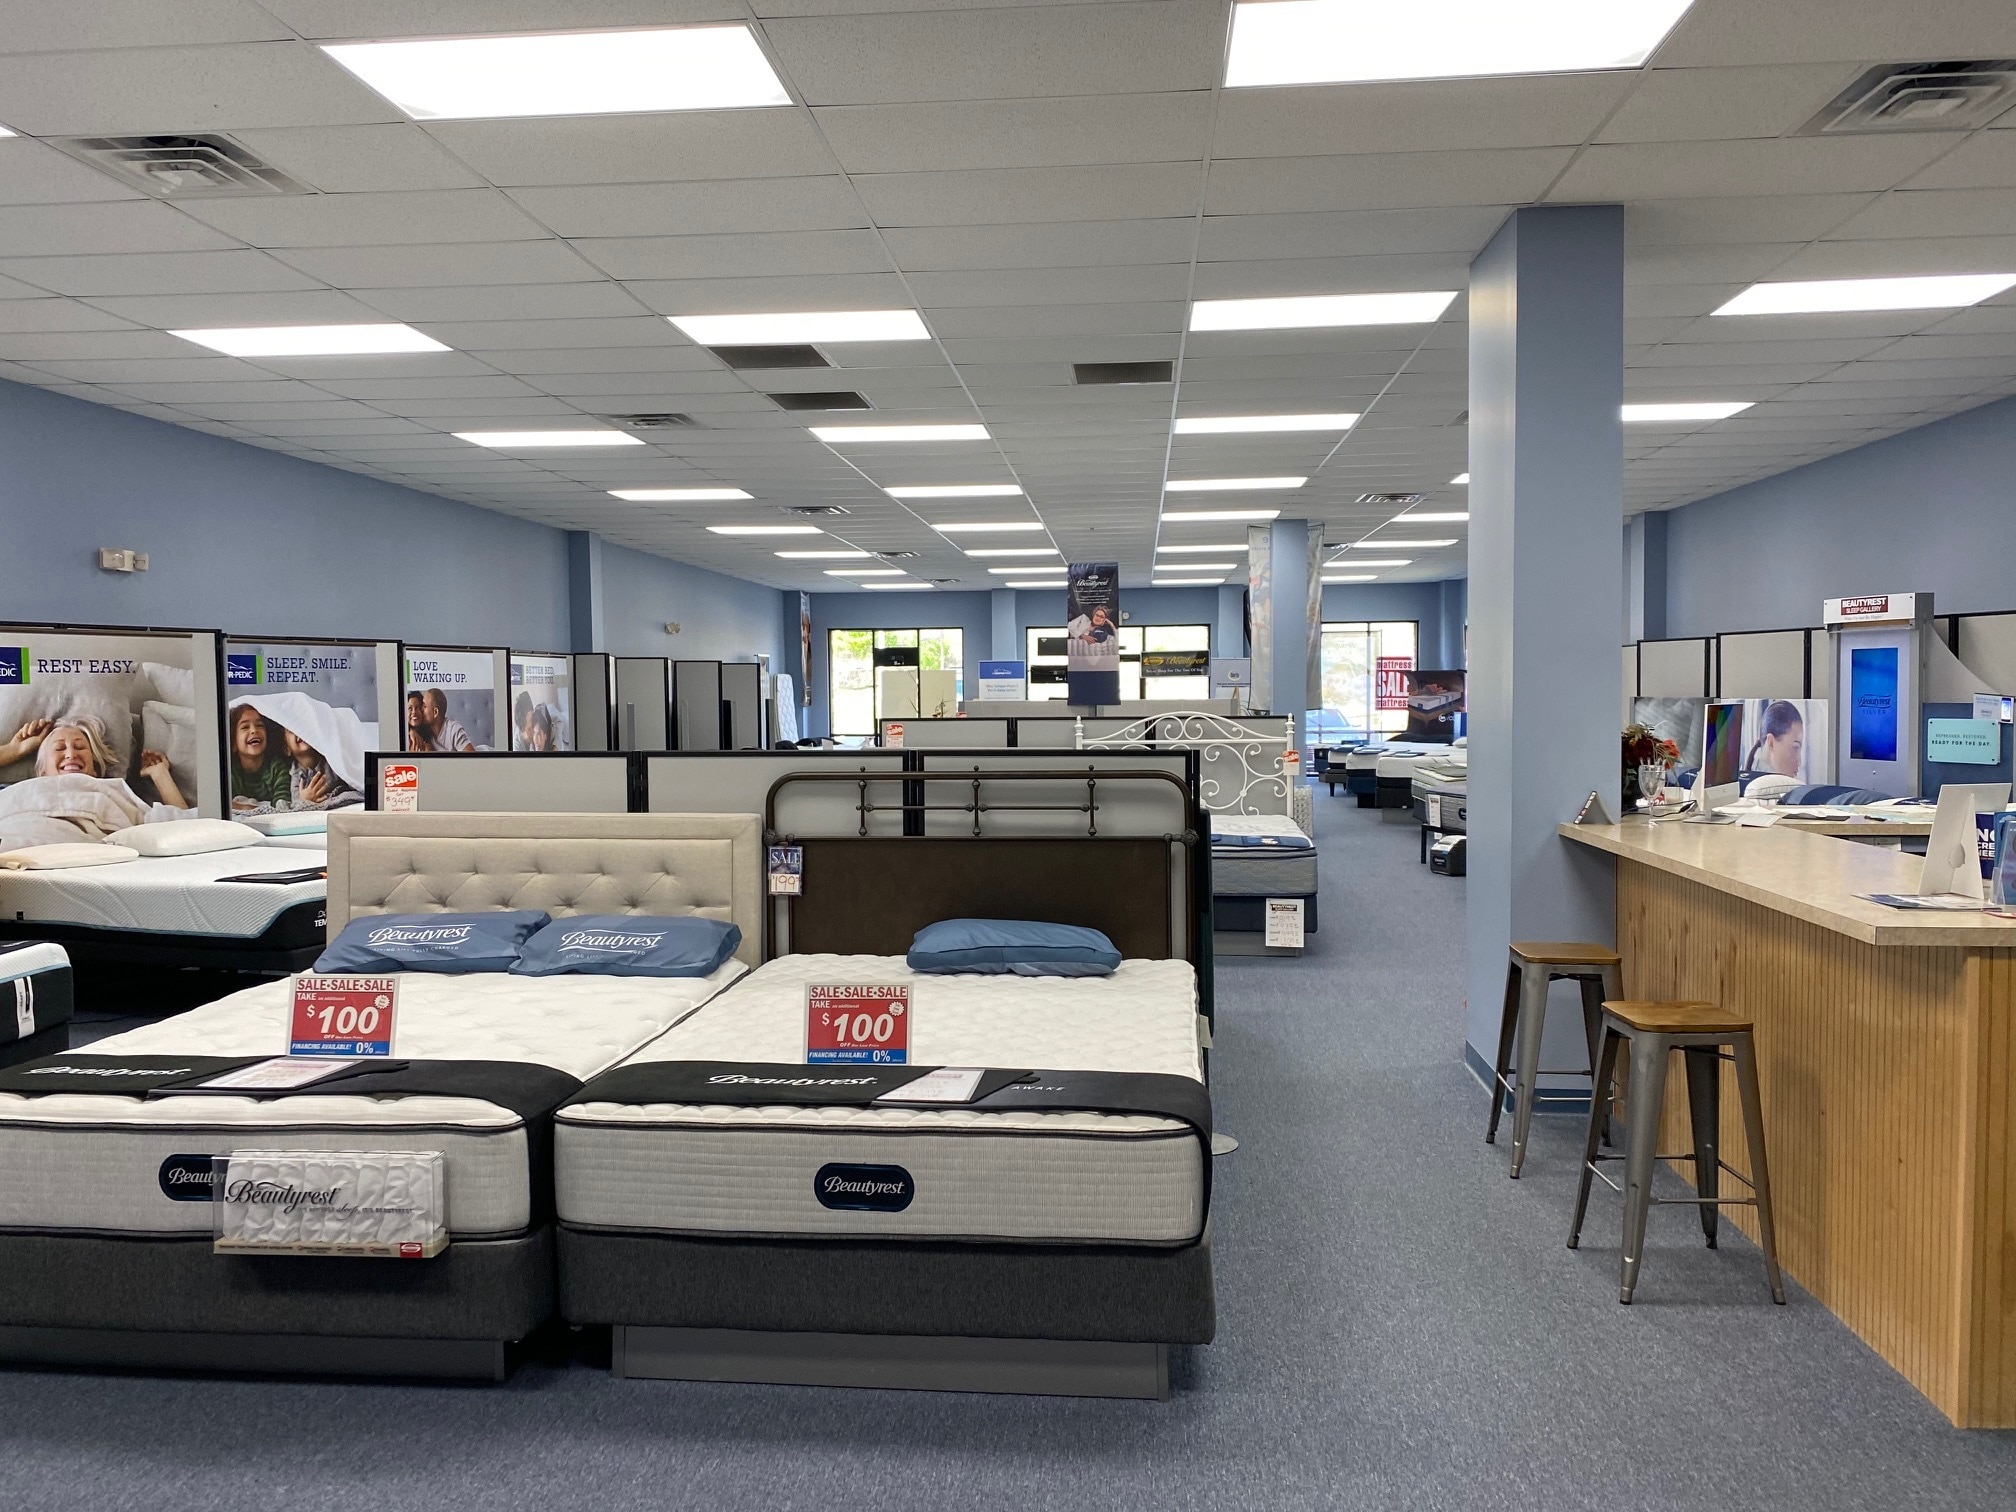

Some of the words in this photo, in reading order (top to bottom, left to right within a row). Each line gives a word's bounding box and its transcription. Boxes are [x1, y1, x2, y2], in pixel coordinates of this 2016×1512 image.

[1842, 597, 1887, 608] BEAUTYREST
[37, 659, 83, 673] REST
[89, 659, 137, 674] EASY.
[267, 657, 308, 669] SLEEP.
[311, 658, 351, 670] SMILE.
[413, 661, 438, 671] LOVE
[1376, 661, 1412, 669] mattress
[267, 671, 319, 683] REPEAT.
[413, 673, 452, 683] WAKING
[454, 673, 468, 683] UP.
[1376, 699, 1409, 707] mattres
[385, 769, 417, 787] sale
[771, 851, 800, 864] SALE
[368, 926, 473, 943] Beautyrest
[560, 930, 664, 949] Beautyrest
[296, 992, 317, 1001] TAKE
[810, 1000, 830, 1009] TAKE
[355, 1042, 374, 1054] 0%
[808, 1051, 838, 1059] FINANCING
[838, 1051, 869, 1059] AVAILABLE!
[872, 1050, 891, 1062] 0%
[704, 1074, 877, 1086] Beautyrest
[168, 1167, 227, 1187] Beautyr
[824, 1176, 905, 1196] Beautyrest
[225, 1178, 338, 1214] Beautyrest
